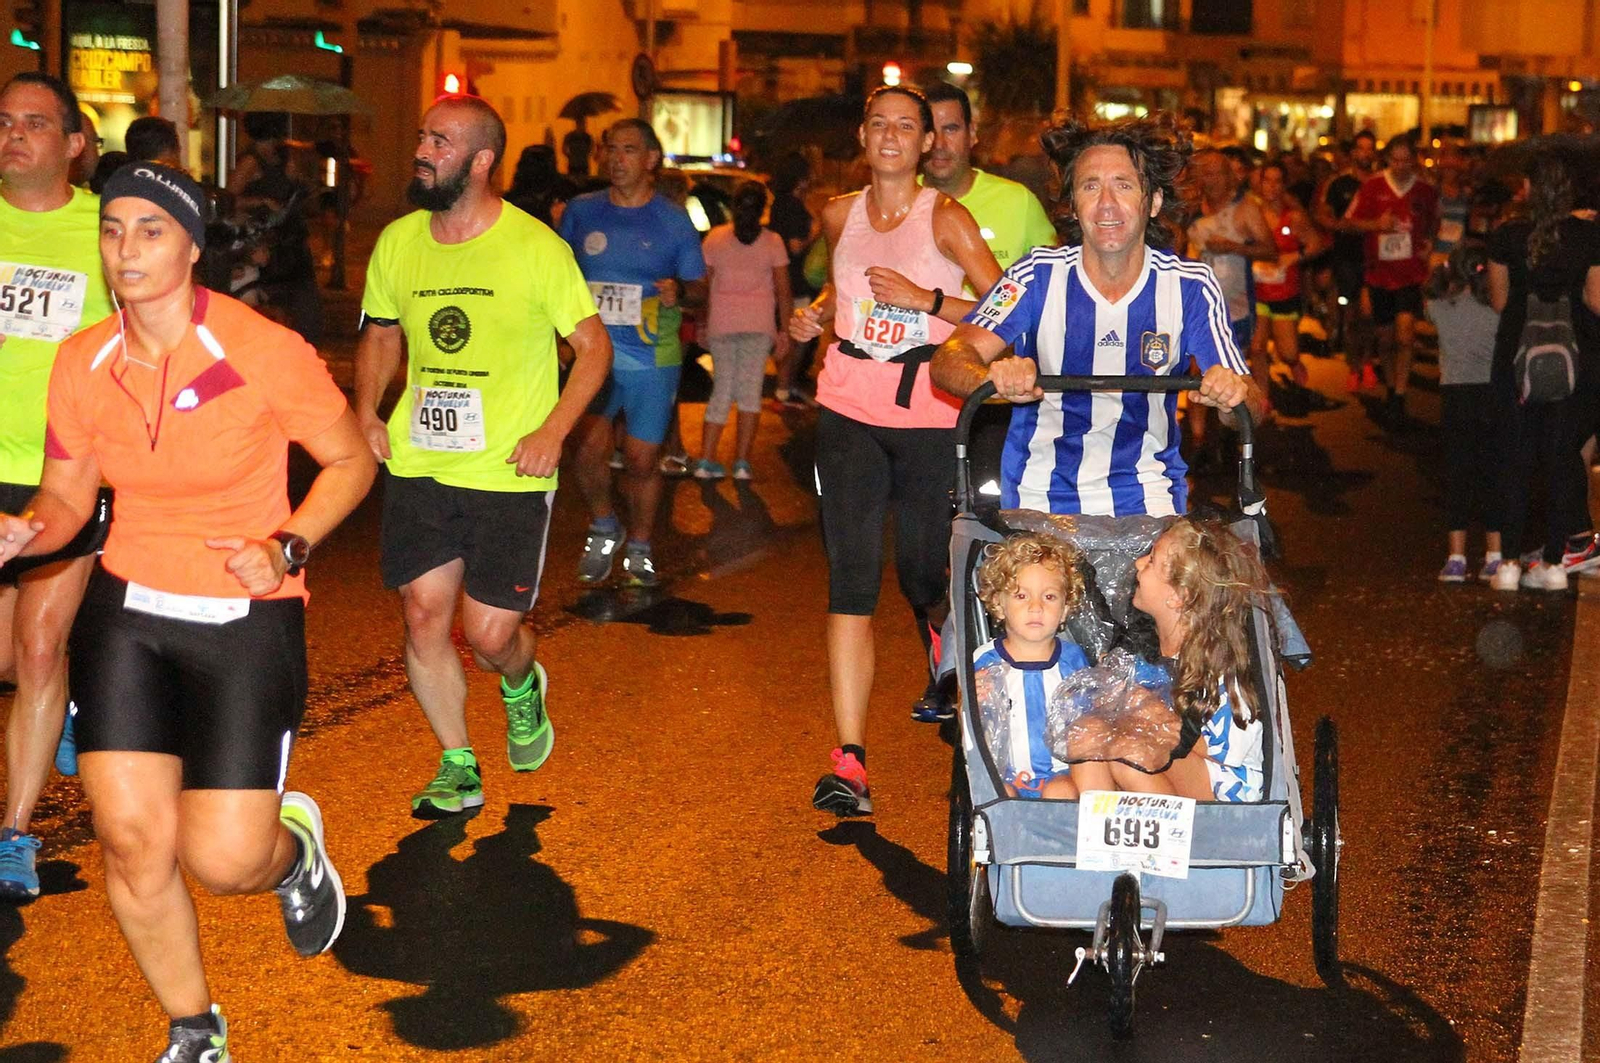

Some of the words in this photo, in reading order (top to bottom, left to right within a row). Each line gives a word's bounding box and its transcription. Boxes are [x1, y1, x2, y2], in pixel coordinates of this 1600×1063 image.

[71, 49, 152, 72] CRUZCAMPO
[15, 267, 76, 283] NOCTURNA
[0, 285, 51, 317] 521
[597, 295, 623, 312] 711
[983, 306, 1000, 317] LFP
[864, 317, 905, 344] 620
[426, 390, 471, 399] NOCTURNA
[420, 407, 458, 432] 490
[1104, 816, 1160, 849] 693
